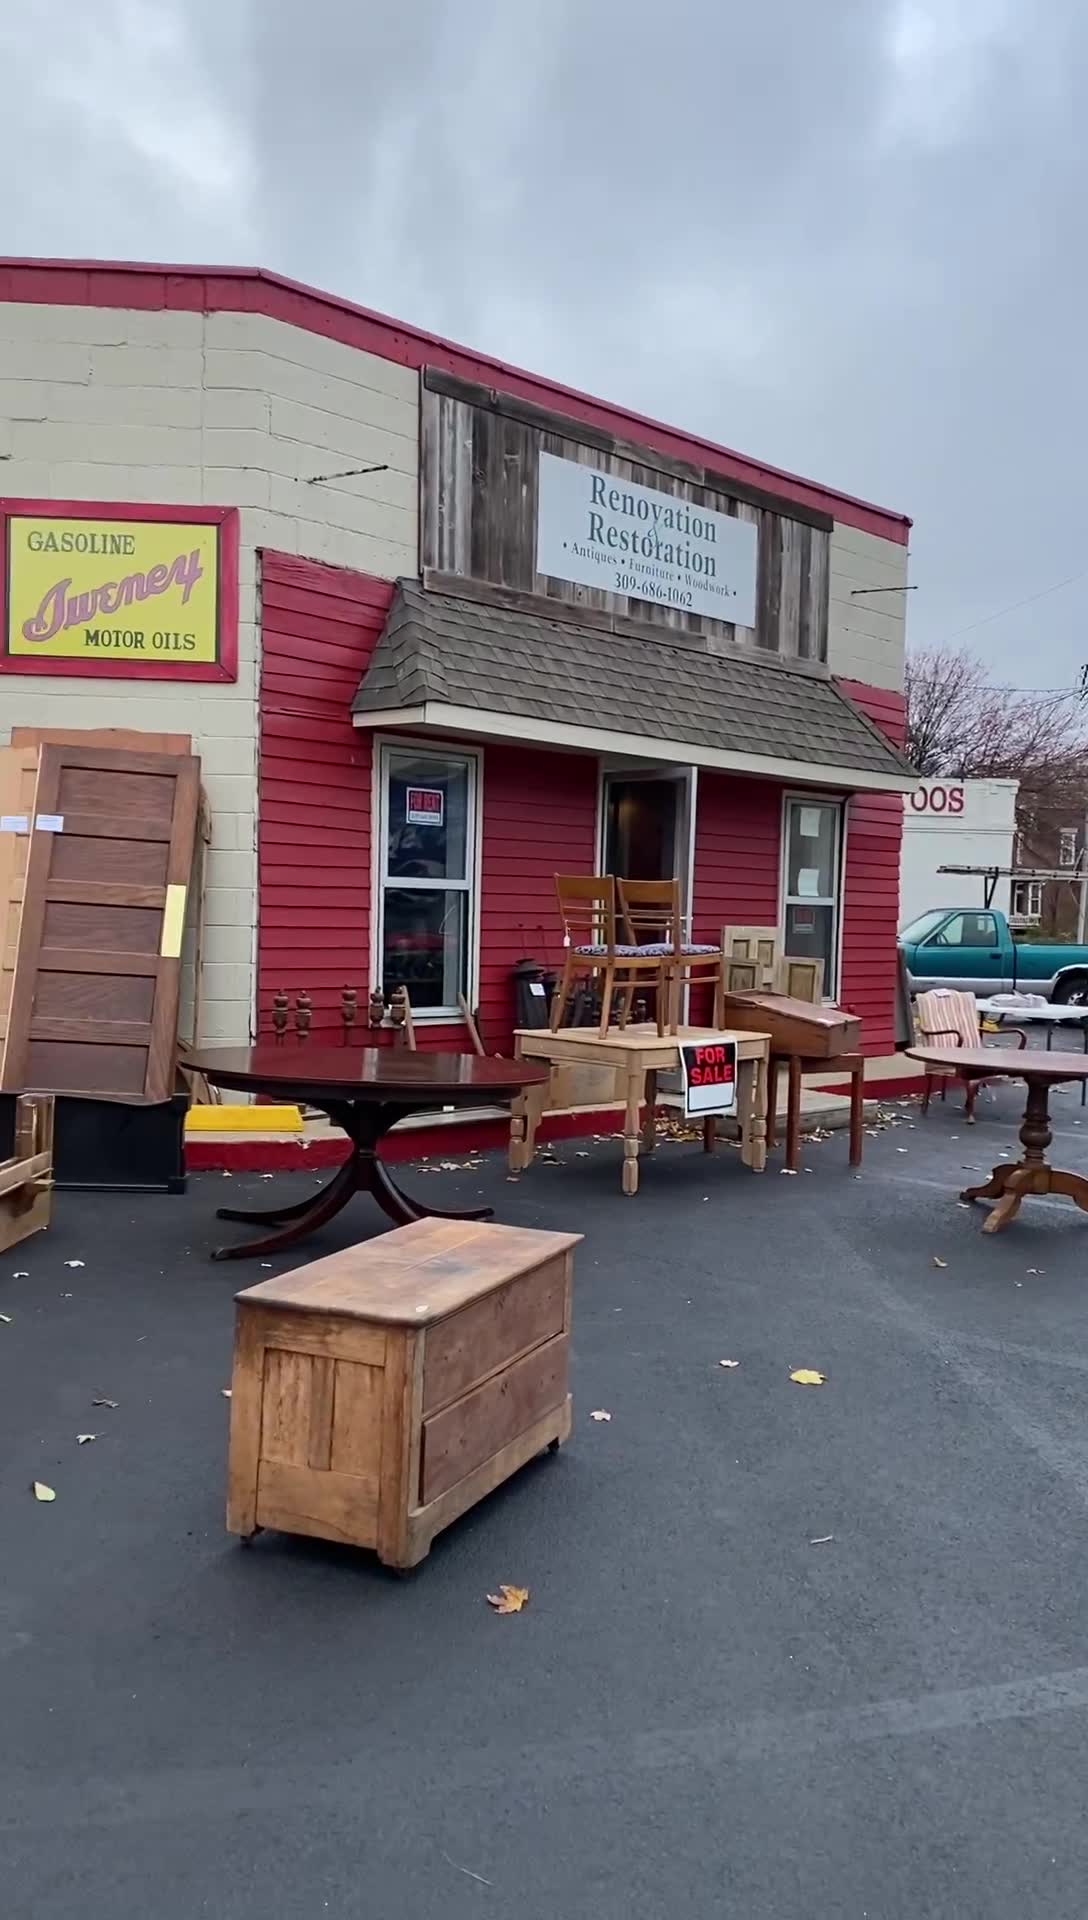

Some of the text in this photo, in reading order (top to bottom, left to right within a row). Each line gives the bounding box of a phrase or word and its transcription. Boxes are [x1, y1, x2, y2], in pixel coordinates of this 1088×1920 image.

[590, 474, 717, 543] Renovation
[27, 531, 135, 555] GASOLINE
[587, 511, 716, 577] Restoration
[571, 542, 730, 597] Antiques Furniture Woodwork
[615, 572, 693, 607] 309-686-1062
[84, 629, 196, 650] MOTOR OILS
[695, 1046, 725, 1065] FOR
[690, 1065, 732, 1085] SALE
